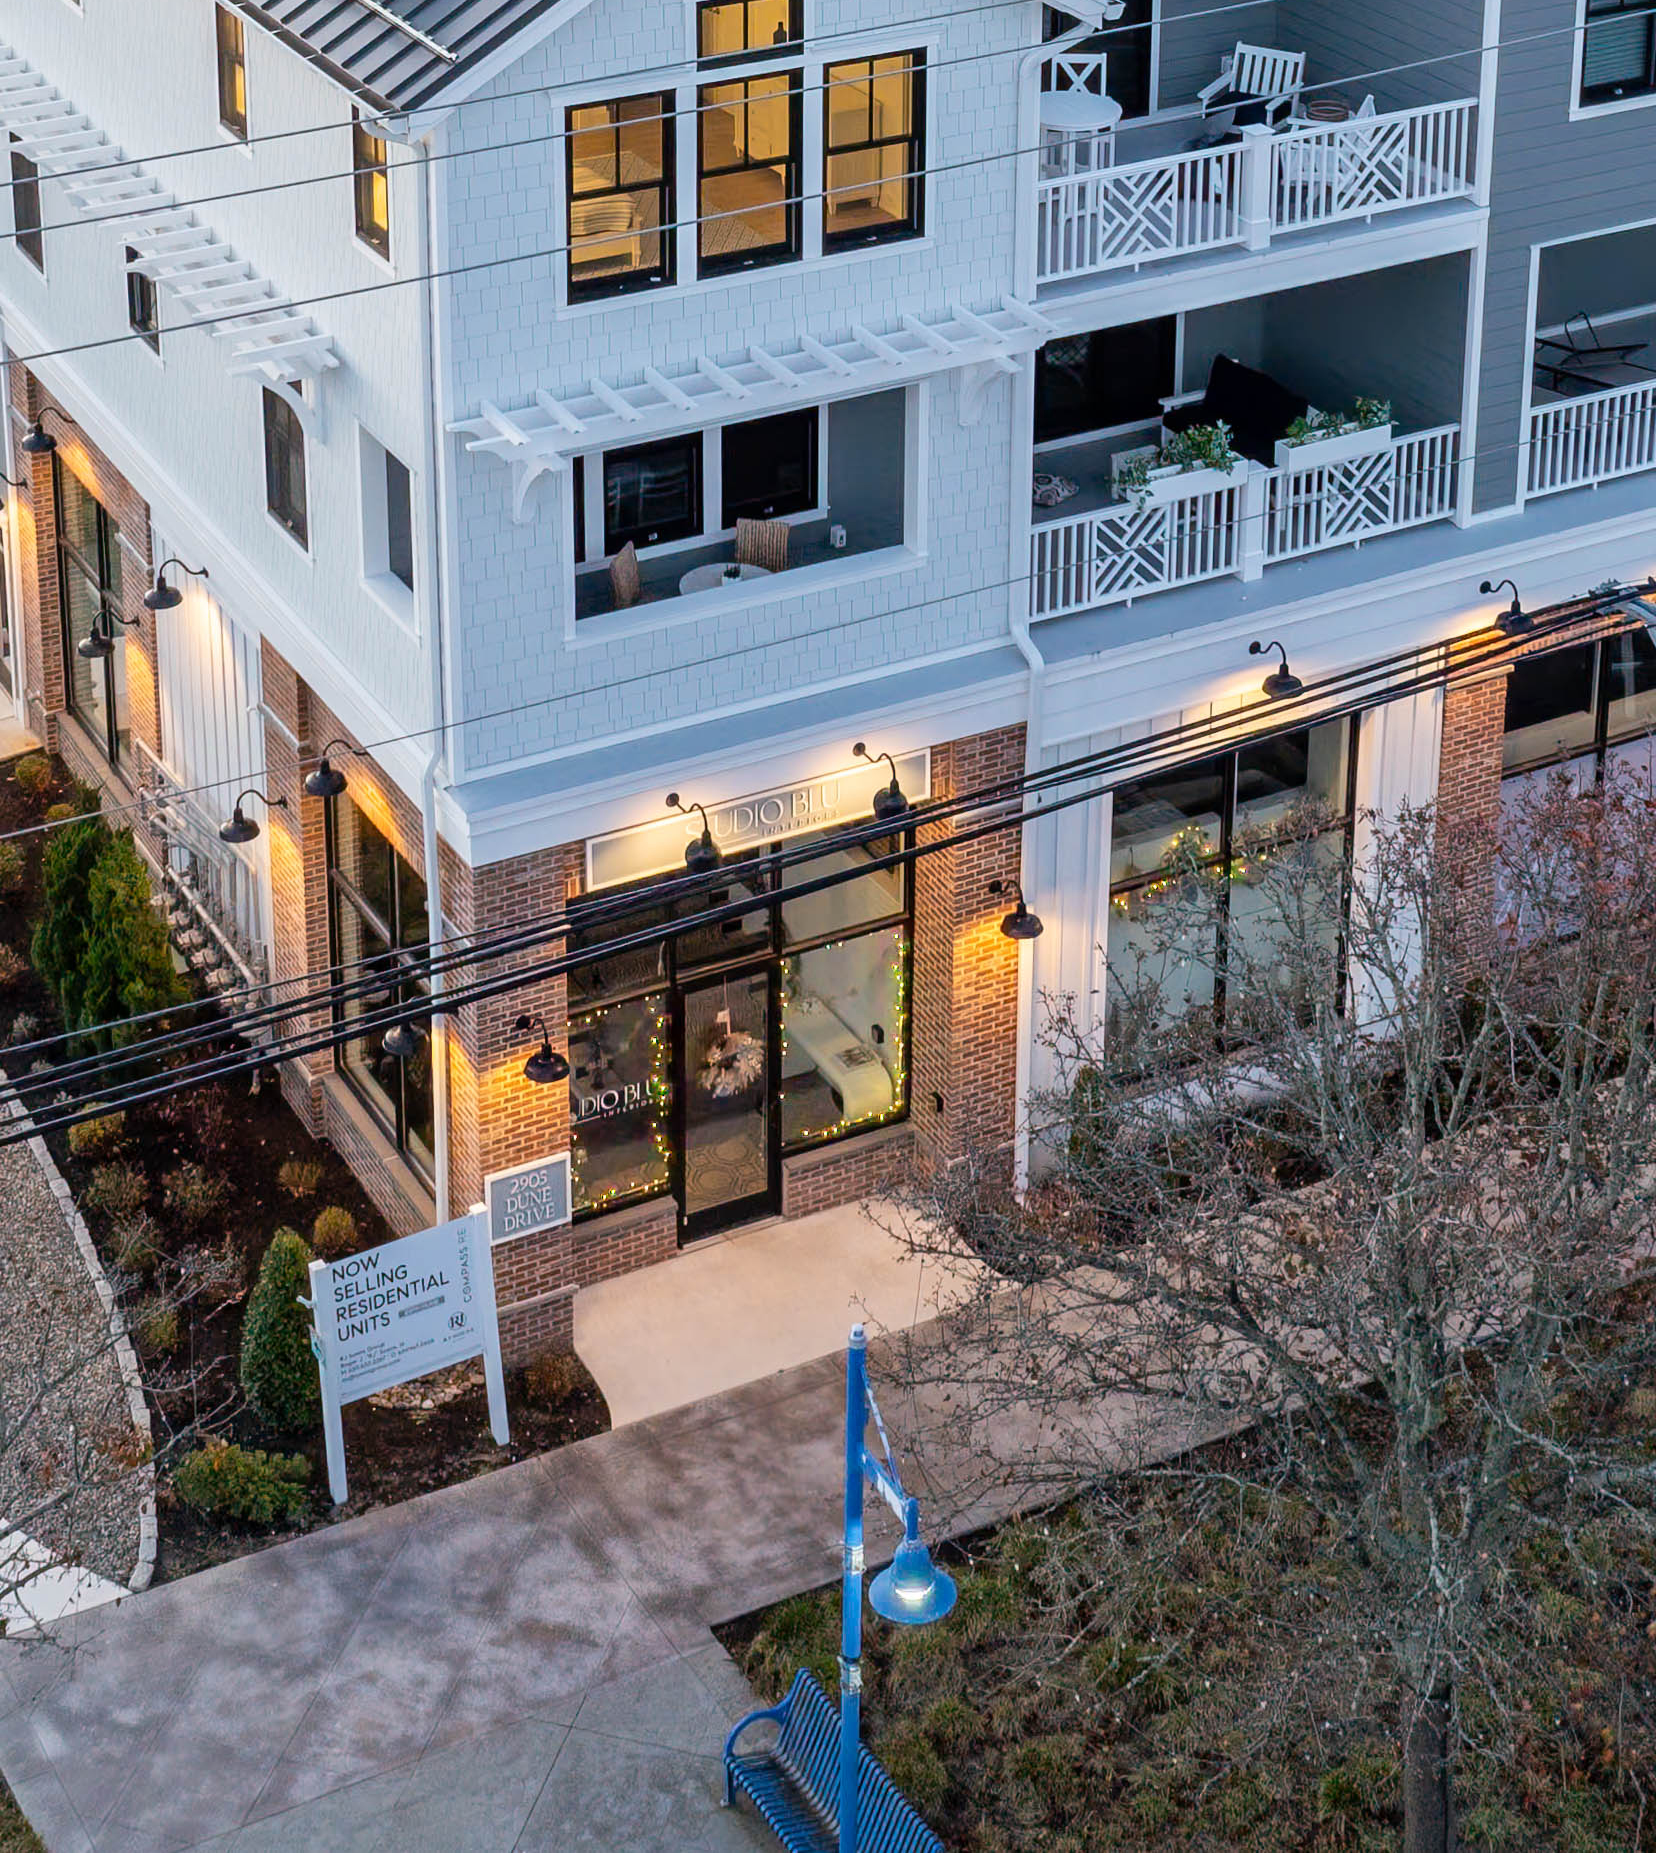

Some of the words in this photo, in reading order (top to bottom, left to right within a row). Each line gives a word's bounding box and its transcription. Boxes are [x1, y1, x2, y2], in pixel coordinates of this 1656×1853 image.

[685, 798, 783, 837] SUDIO
[509, 1169, 548, 1196] 2905
[506, 1185, 553, 1214] DUNE
[504, 1201, 556, 1232] DRIVE
[332, 1252, 380, 1283] NOW
[334, 1264, 408, 1303] SELLING
[336, 1271, 450, 1323] RESIDENTIAL
[338, 1311, 391, 1342] UNITS
